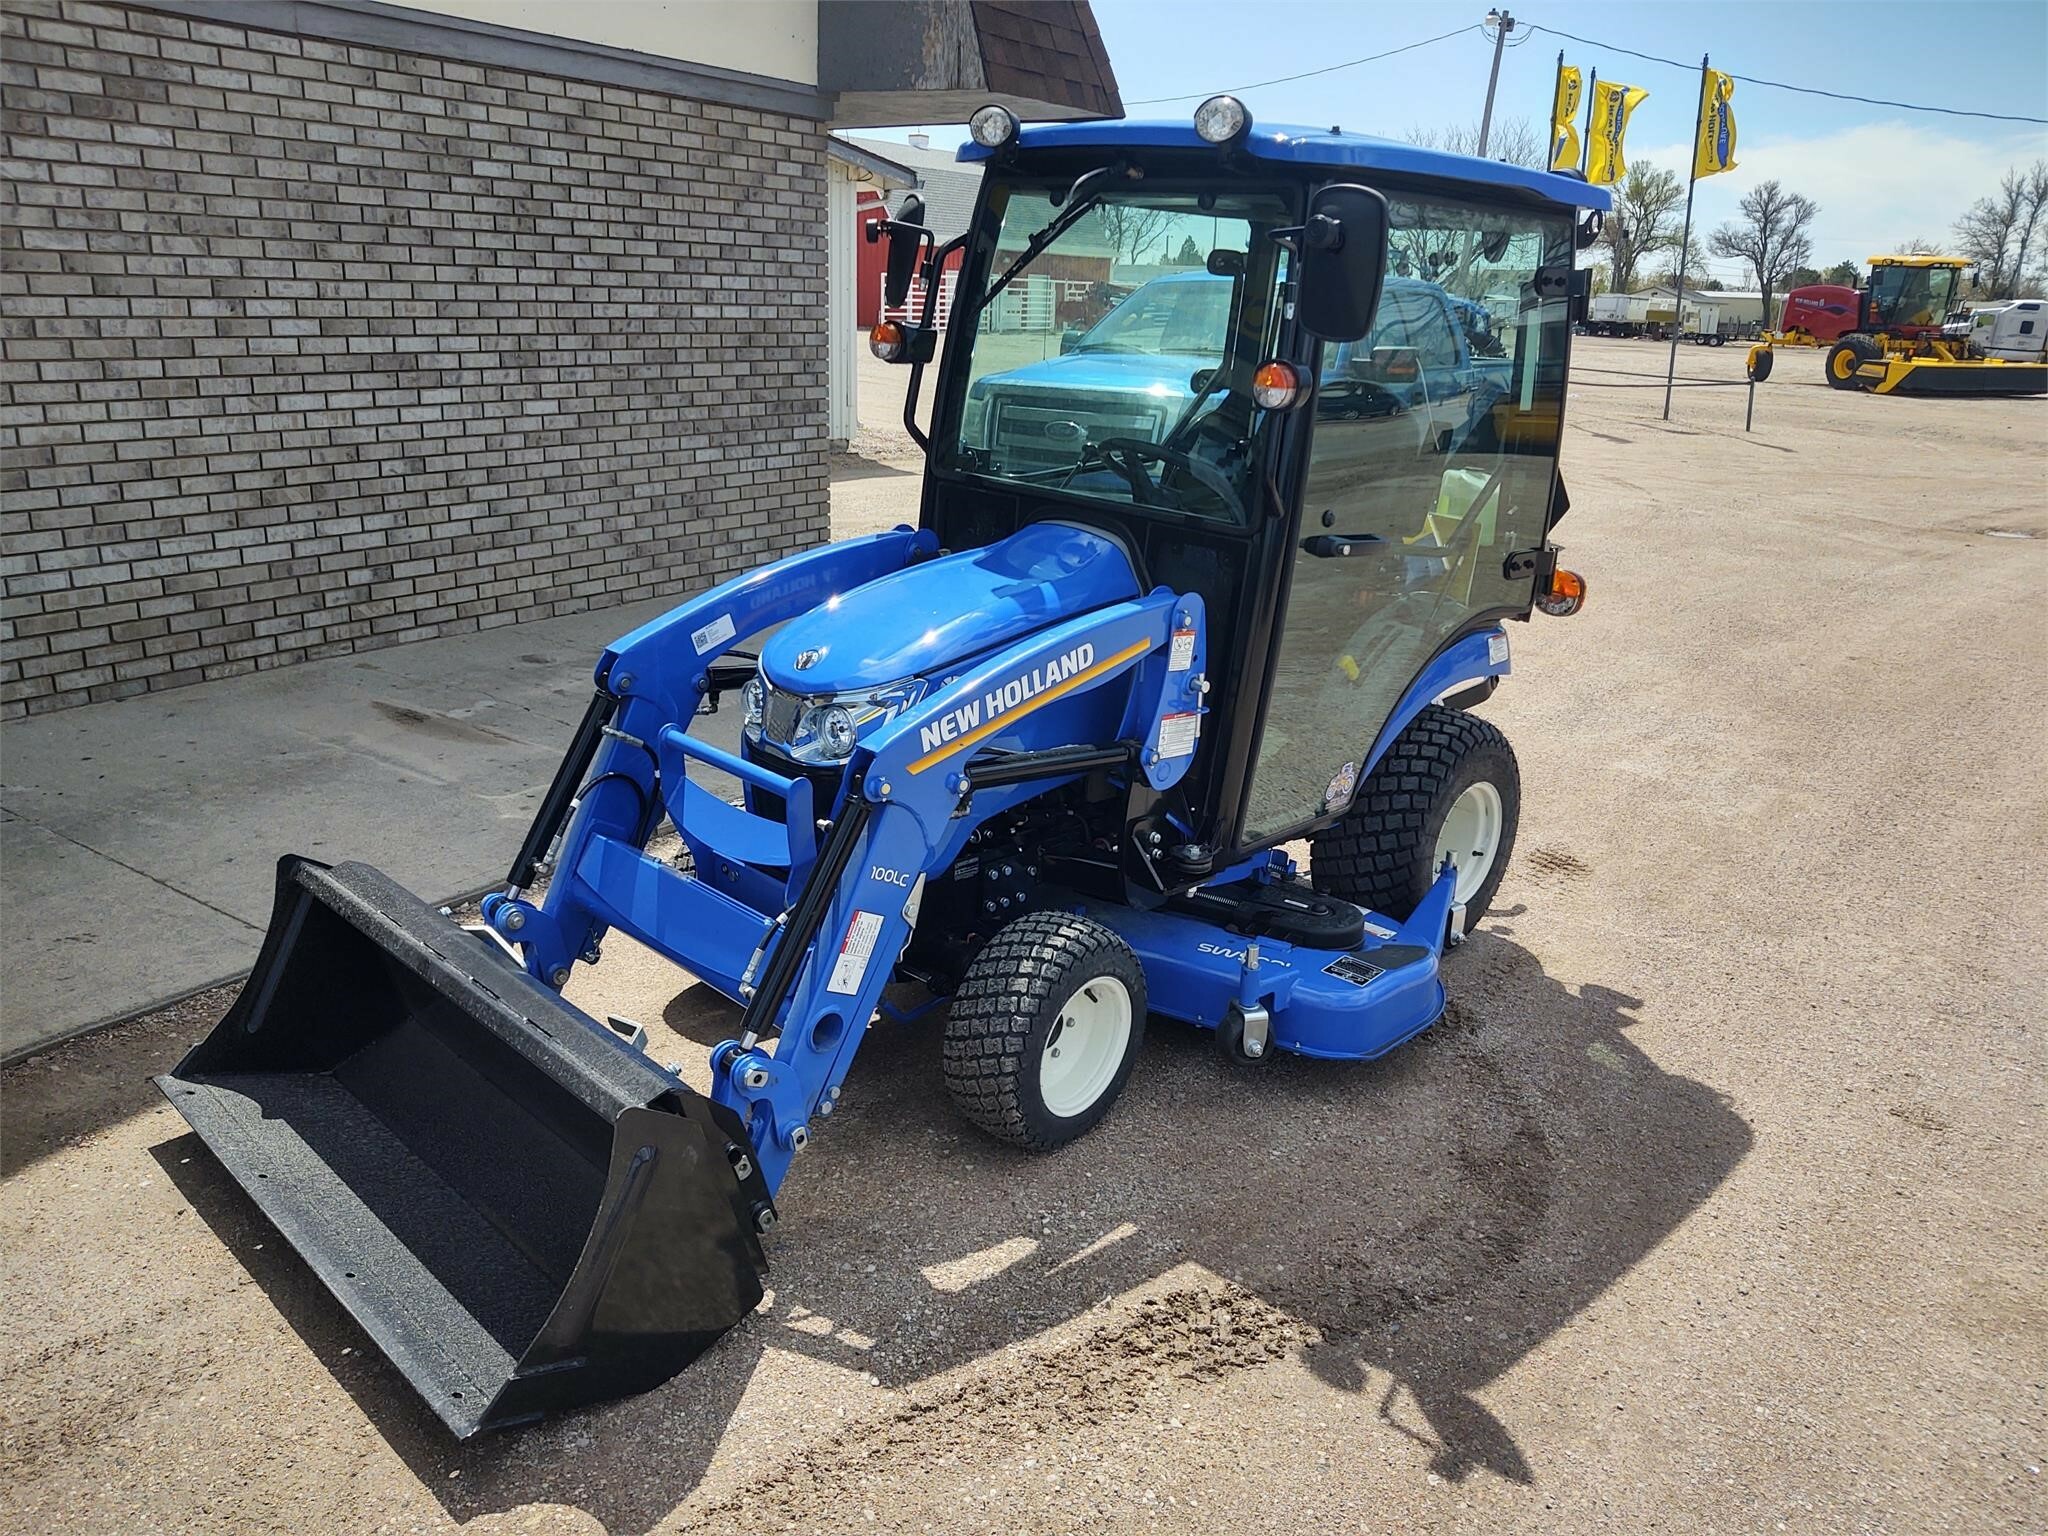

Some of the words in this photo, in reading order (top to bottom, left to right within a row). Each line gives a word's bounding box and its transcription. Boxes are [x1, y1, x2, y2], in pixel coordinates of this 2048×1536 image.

[919, 699, 980, 754] NEW
[985, 642, 1094, 720] HOLLAND
[870, 865, 910, 887] 100LC
